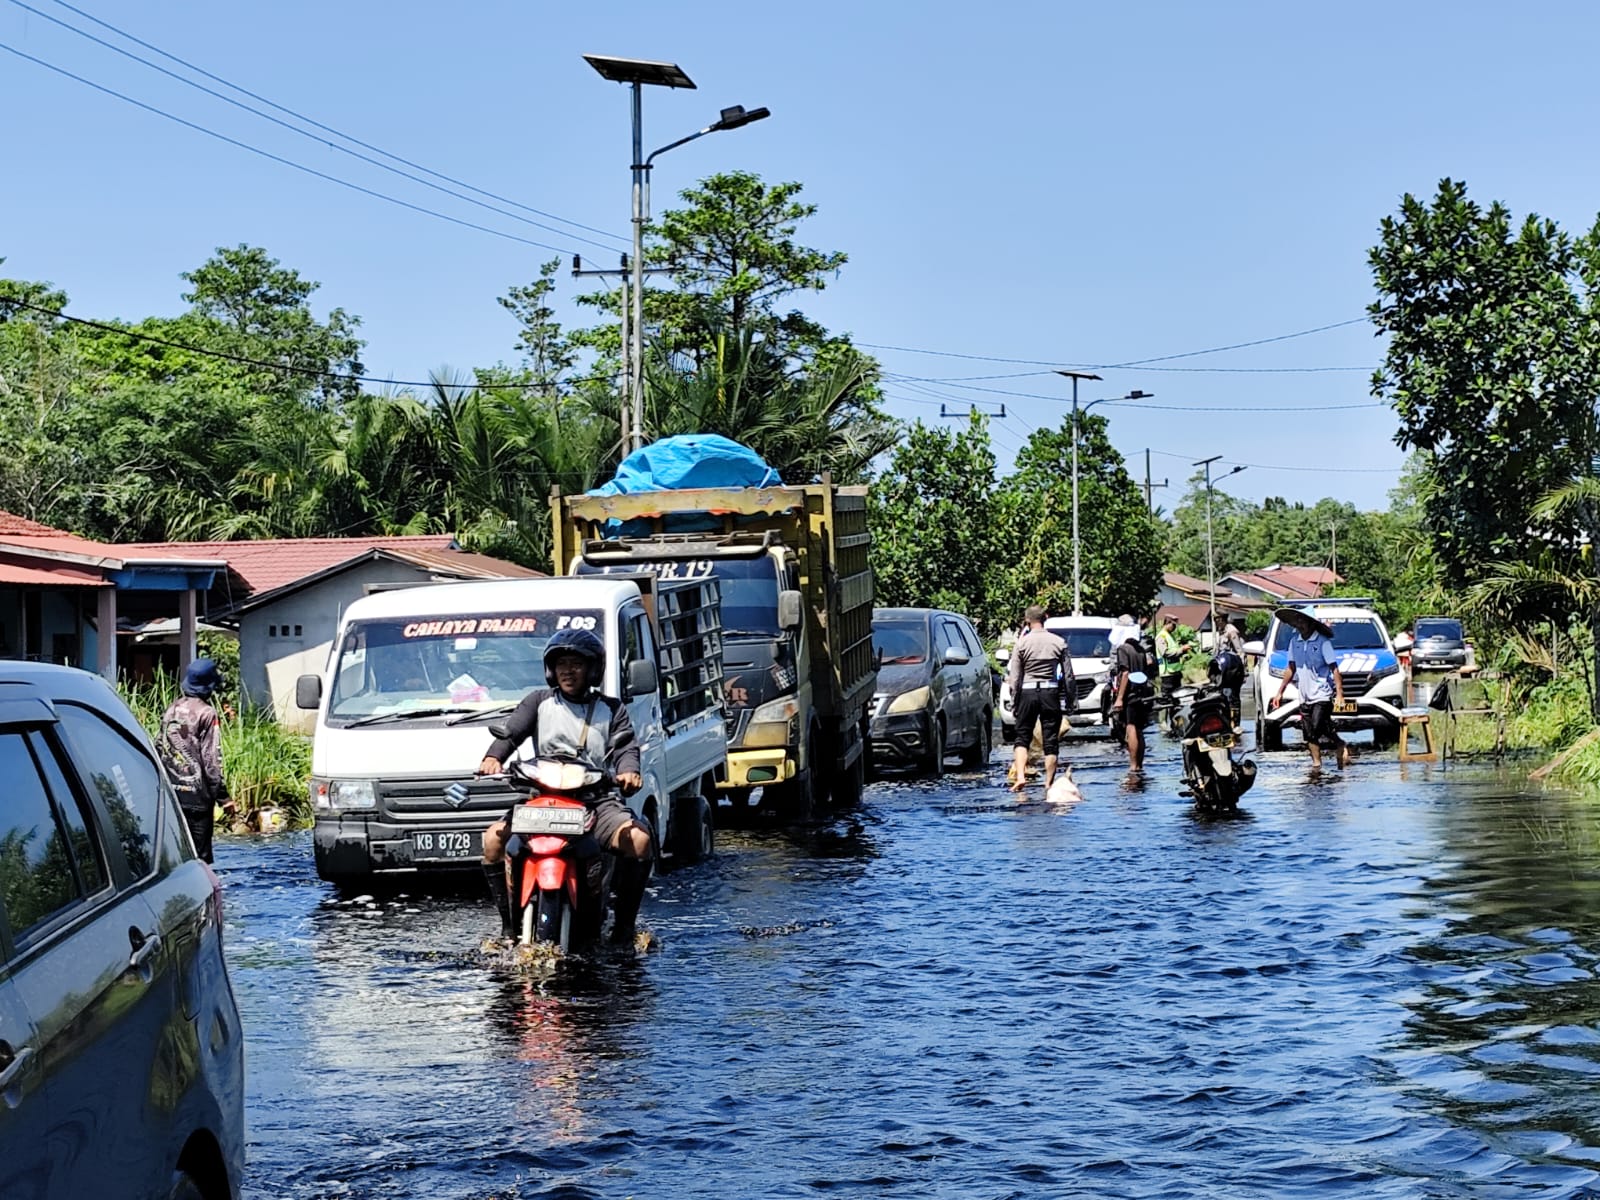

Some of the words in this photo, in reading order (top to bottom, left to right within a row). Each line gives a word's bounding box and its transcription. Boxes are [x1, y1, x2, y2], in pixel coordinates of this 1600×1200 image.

[686, 559, 714, 577] 19
[403, 620, 477, 637] CAHAYA
[478, 617, 537, 633] FAJAR
[556, 616, 570, 629] F
[571, 616, 597, 630] 03
[417, 834, 433, 850] KB
[439, 833, 471, 850] 8728
